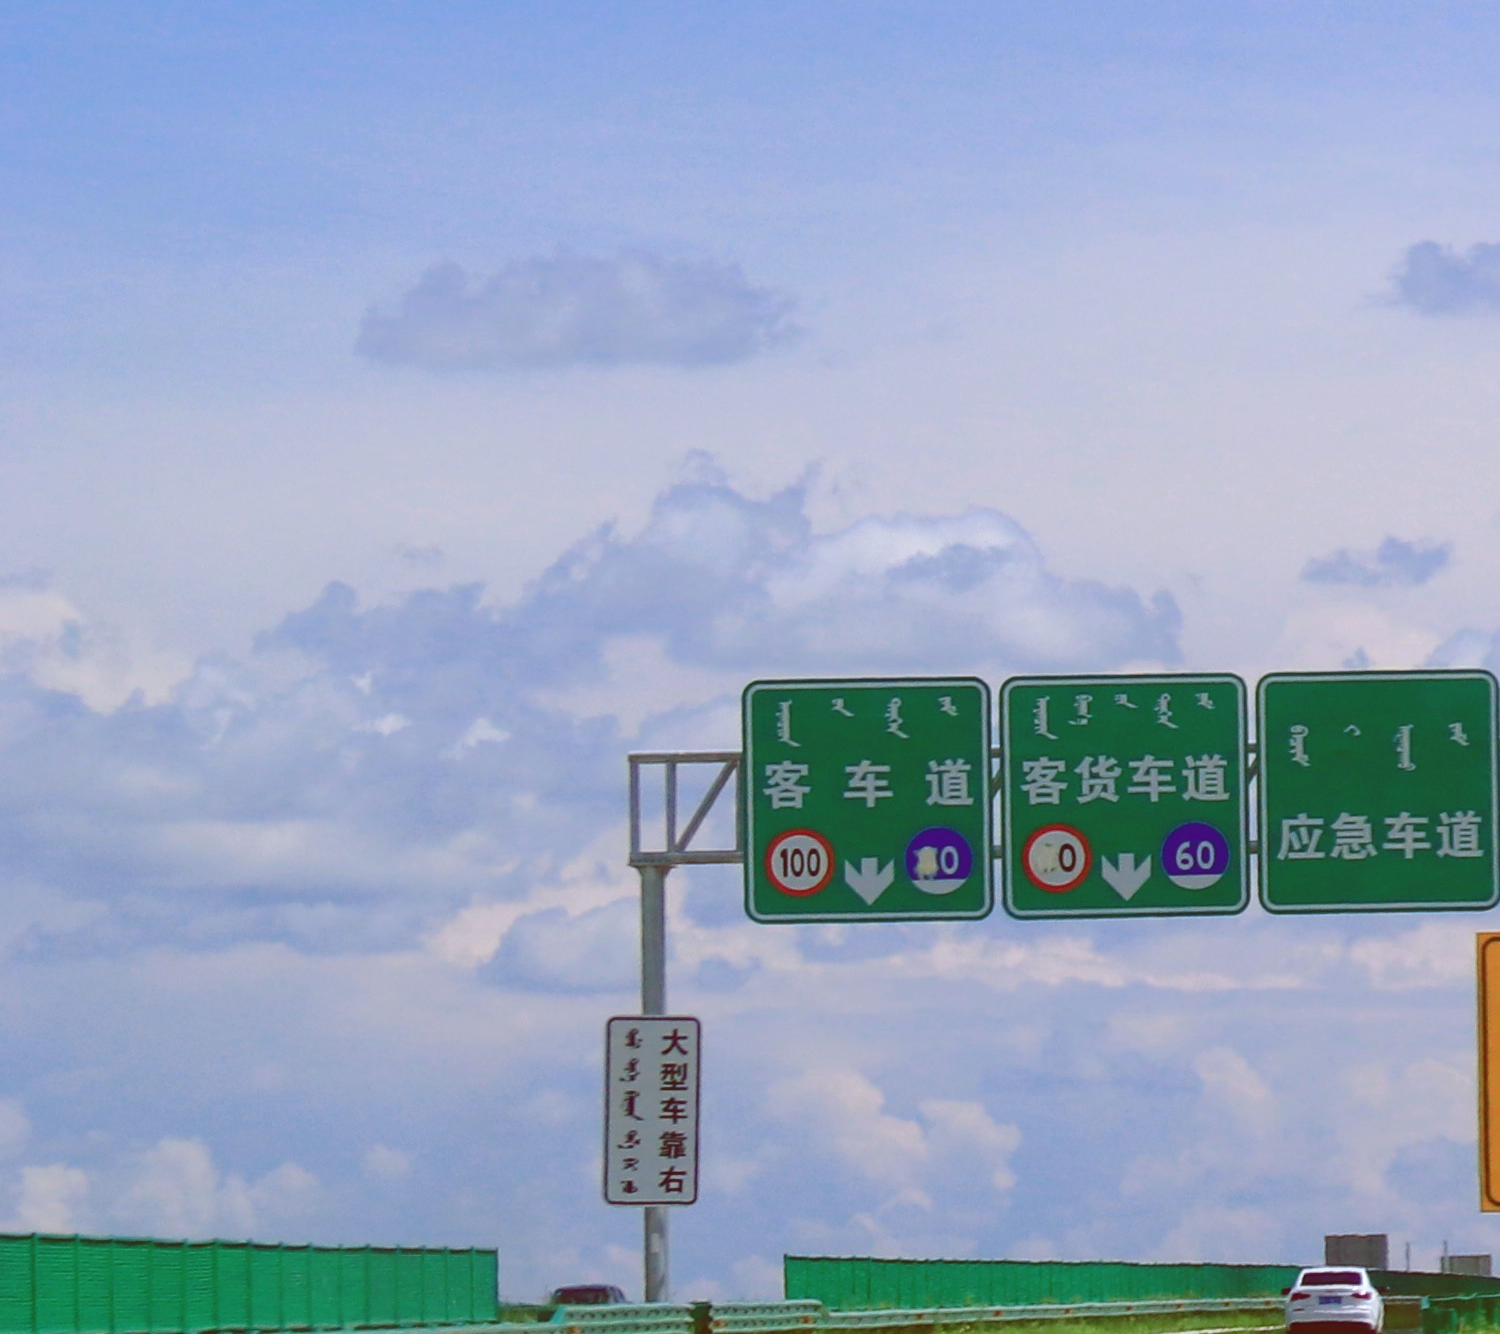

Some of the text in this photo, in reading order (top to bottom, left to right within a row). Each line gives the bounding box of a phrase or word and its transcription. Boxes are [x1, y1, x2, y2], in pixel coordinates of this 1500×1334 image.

[763, 758, 974, 809] 客车道
[1021, 754, 1231, 805] 客货车道
[1175, 840, 1216, 871] 60
[1277, 811, 1484, 860] 应急车道
[780, 848, 821, 877] 100
[658, 1028, 688, 1194] 大型车靠右
